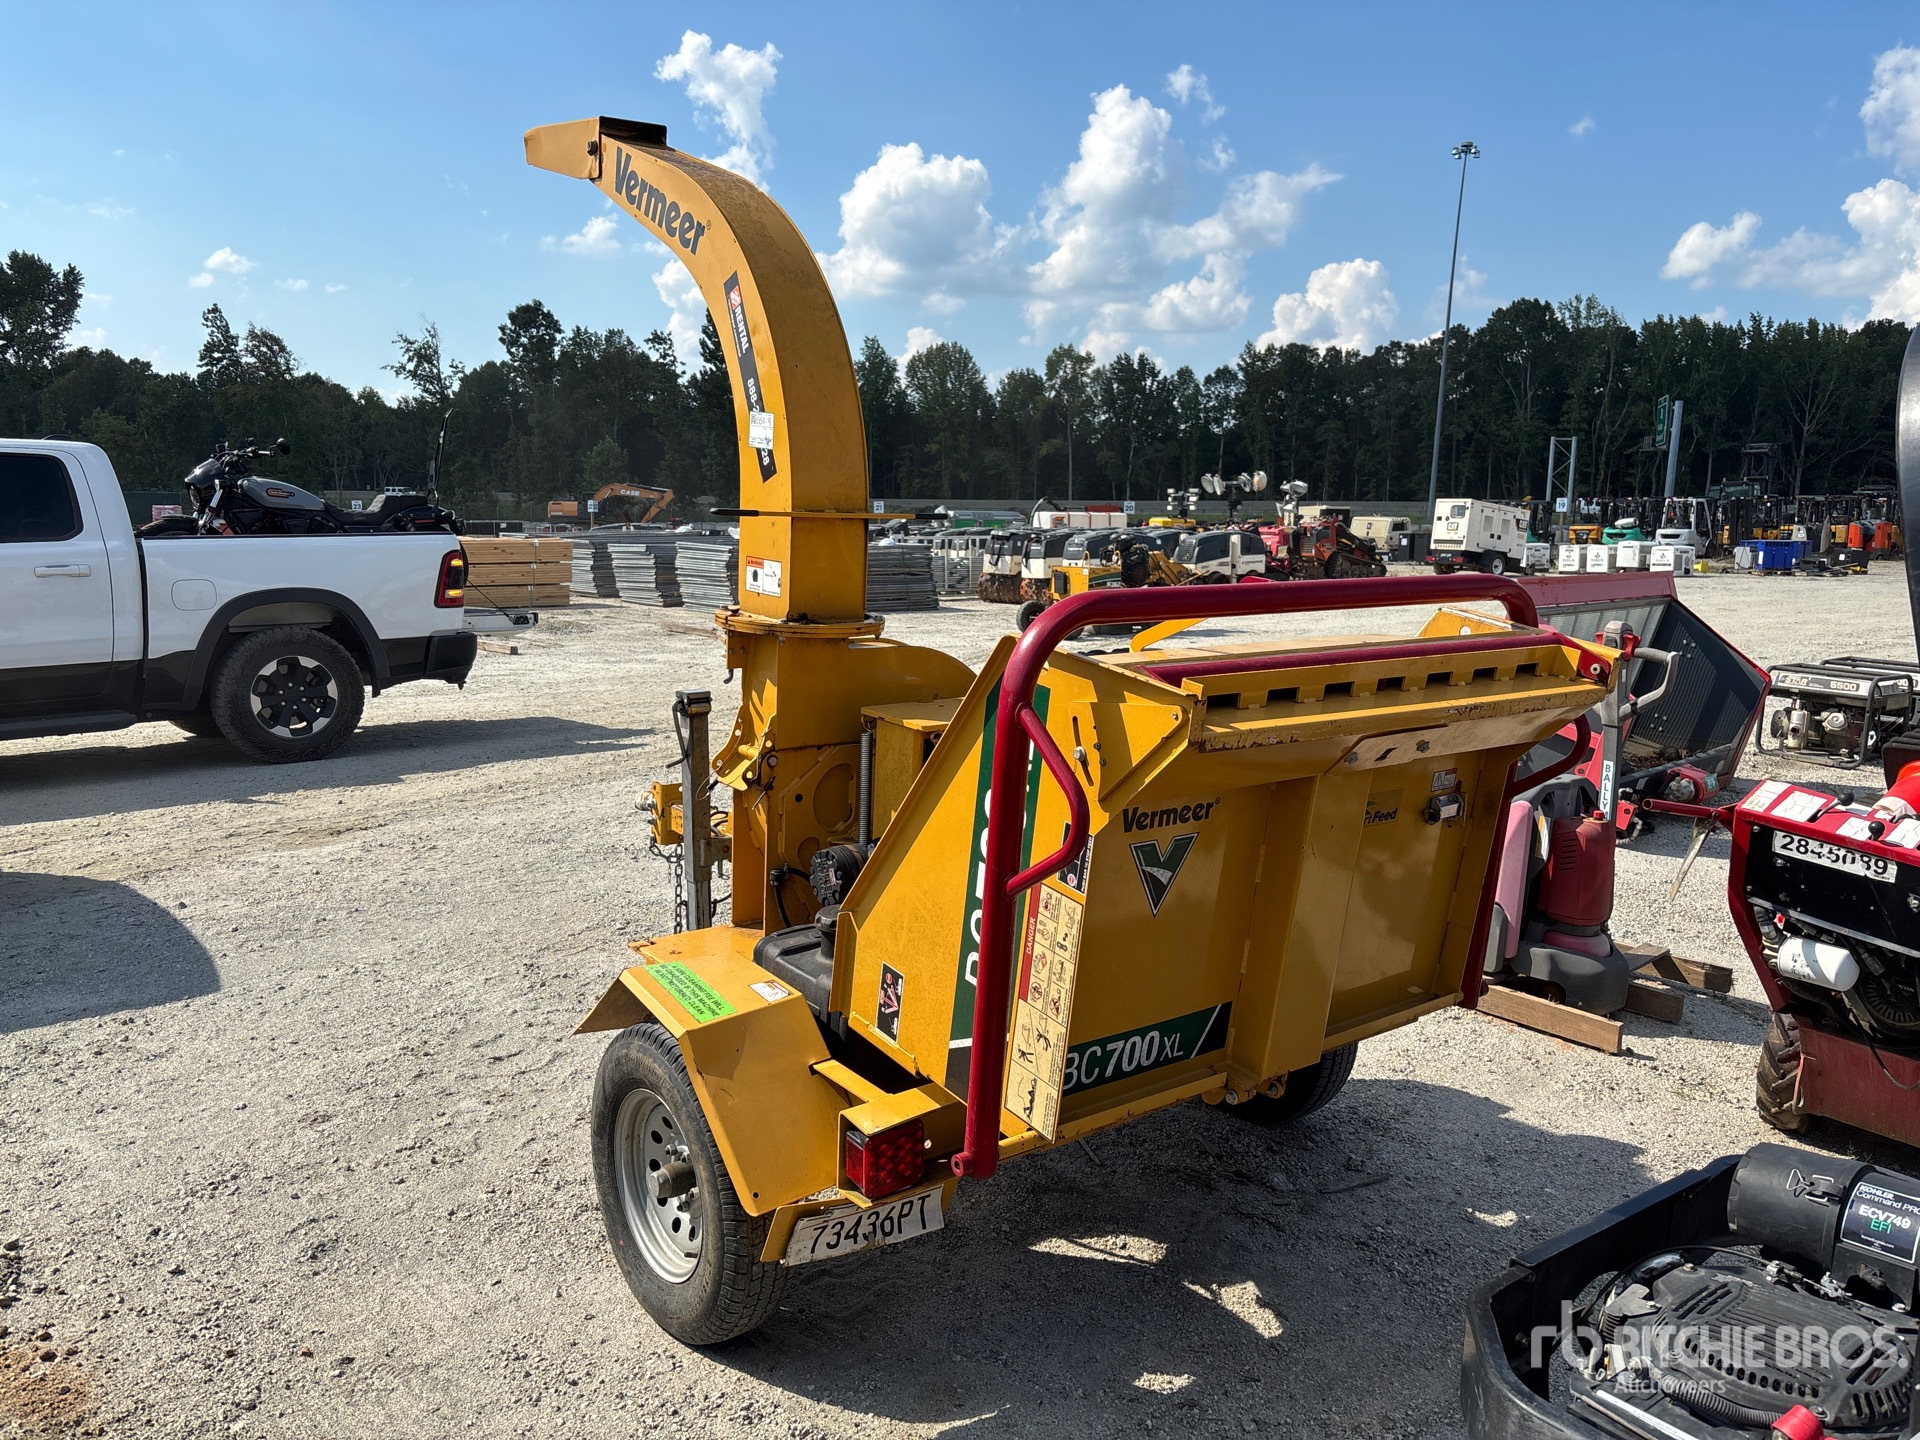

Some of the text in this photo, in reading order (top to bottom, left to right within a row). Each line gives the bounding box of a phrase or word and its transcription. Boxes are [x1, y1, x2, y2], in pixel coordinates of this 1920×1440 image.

[615, 146, 706, 255] Vermeer
[735, 305, 749, 354] RENTAL
[1830, 680, 1857, 691] 5500
[1602, 764, 1610, 819] BALLY
[1122, 802, 1214, 833] Vermeer
[1026, 917, 1036, 955] DANGER
[1856, 1190, 1902, 1209] Command
[1860, 1185, 1895, 1200] KOHLER
[810, 1194, 931, 1254] 73436PT
[1858, 1204, 1912, 1229] ECV749
[1870, 1218, 1892, 1234] EFI
